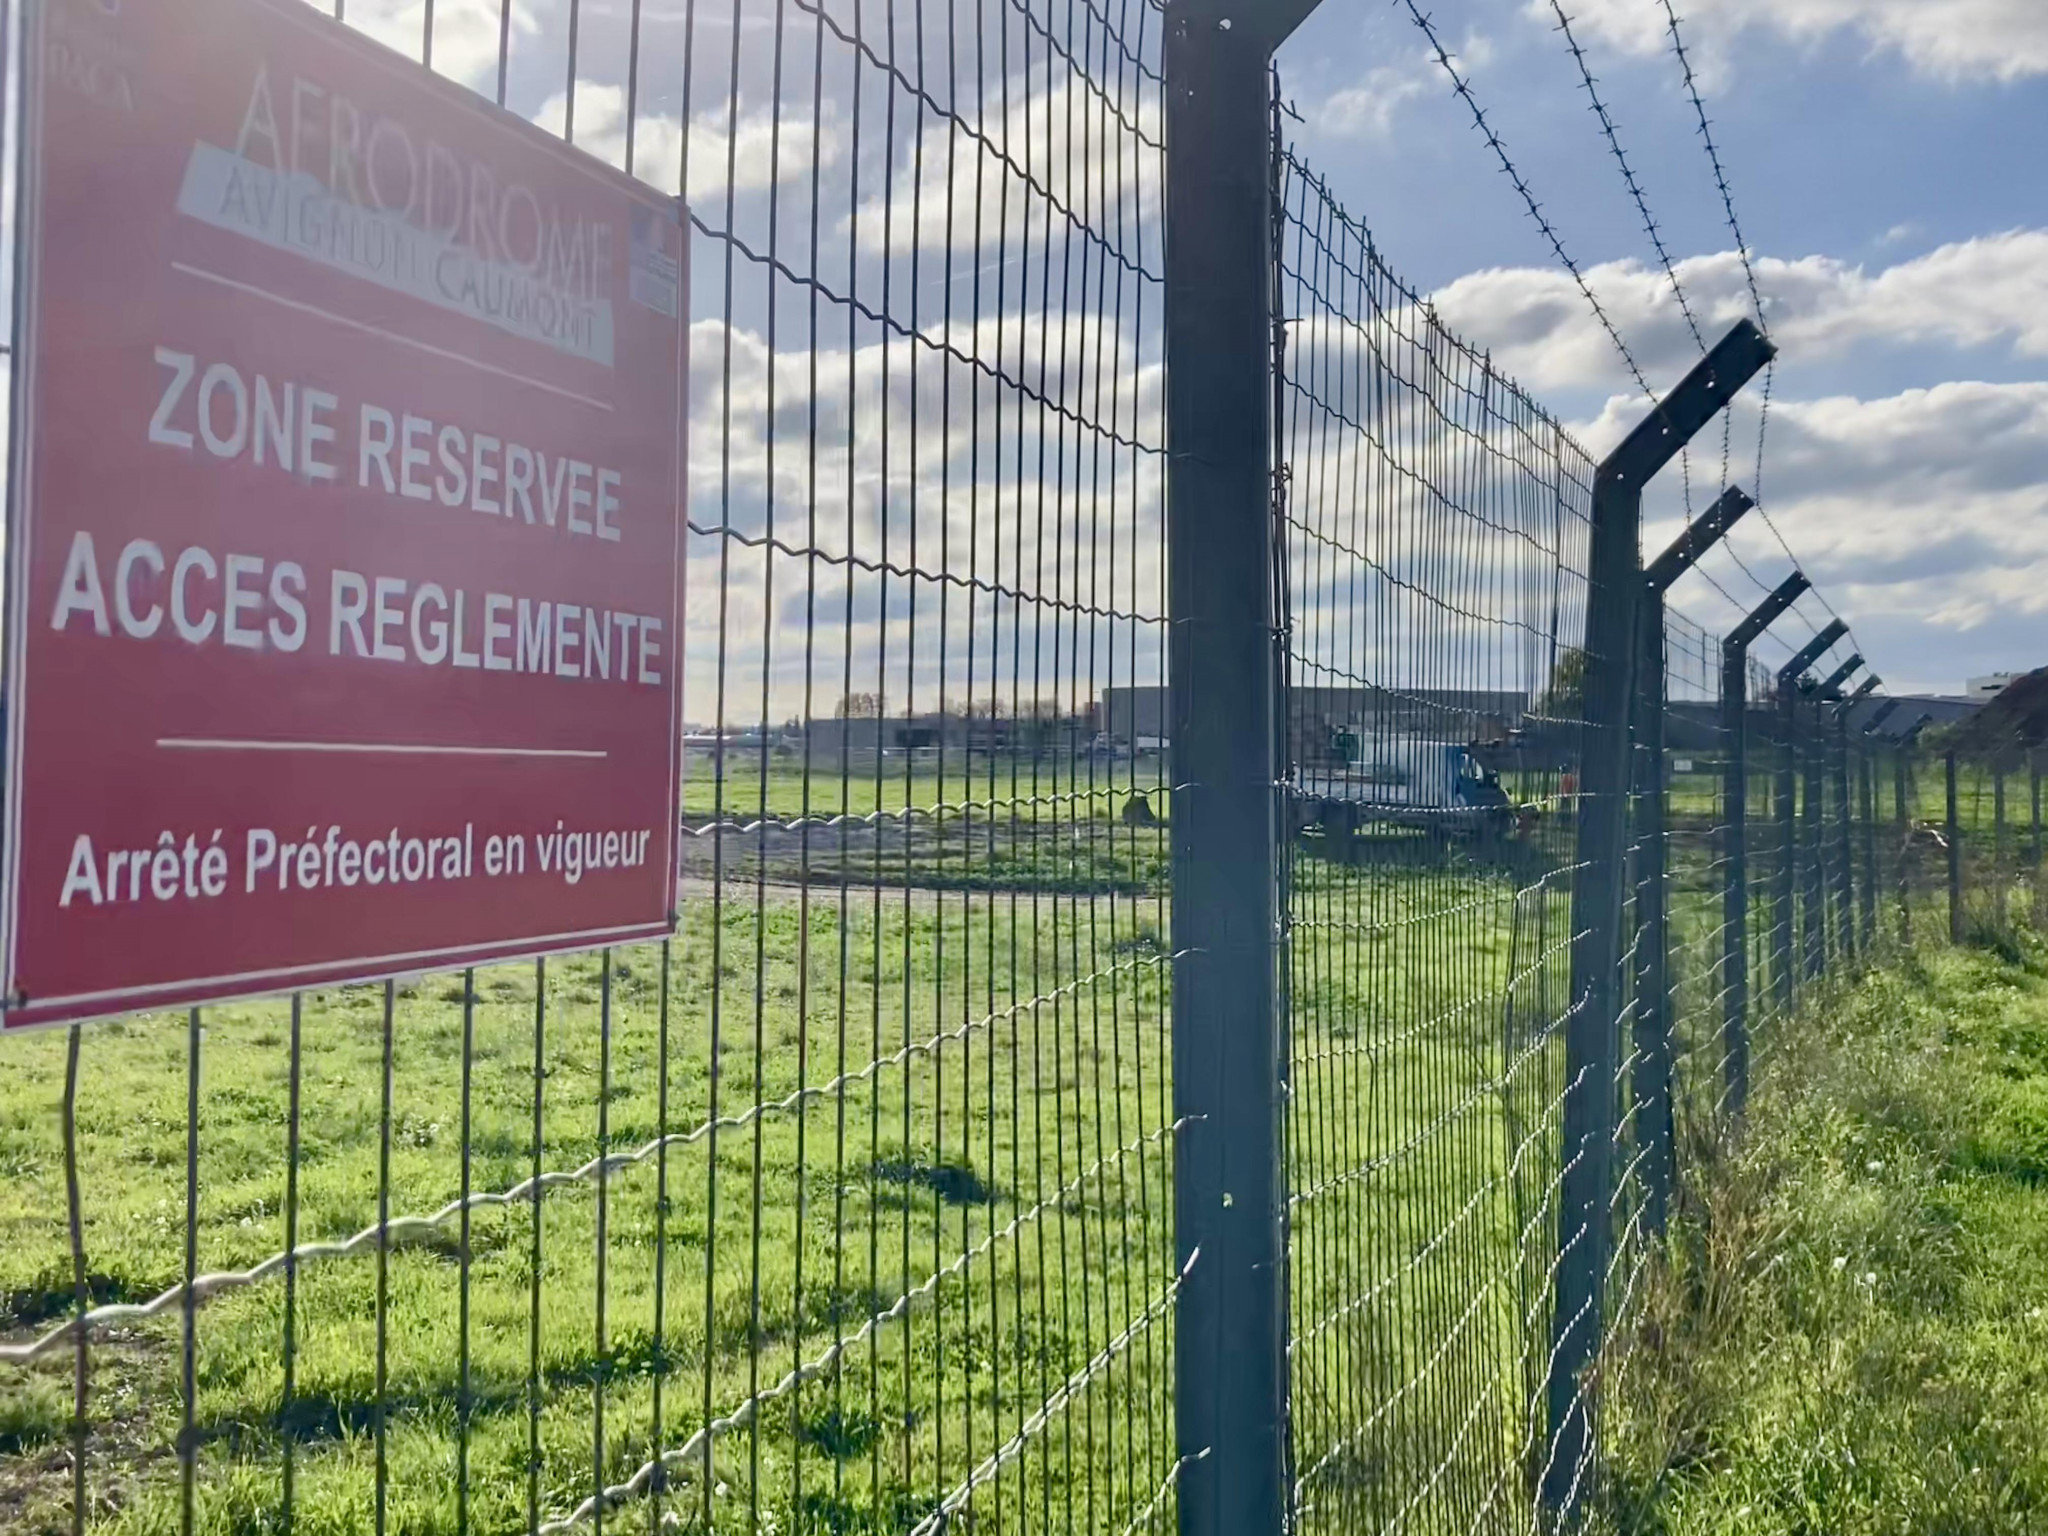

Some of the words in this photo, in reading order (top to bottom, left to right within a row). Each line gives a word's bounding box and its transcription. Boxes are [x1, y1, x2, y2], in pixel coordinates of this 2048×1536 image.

[235, 60, 612, 300] AERODROME
[436, 250, 597, 350] CAUMONT
[148, 345, 338, 480] ZONE
[358, 402, 622, 541] RESERVEE
[50, 530, 306, 652] ACCES
[329, 569, 662, 685] REGLEMENTE
[58, 828, 227, 907] Arrêté
[245, 822, 472, 893] Préfectoral
[484, 834, 524, 876] en
[536, 820, 651, 884] vigueur
